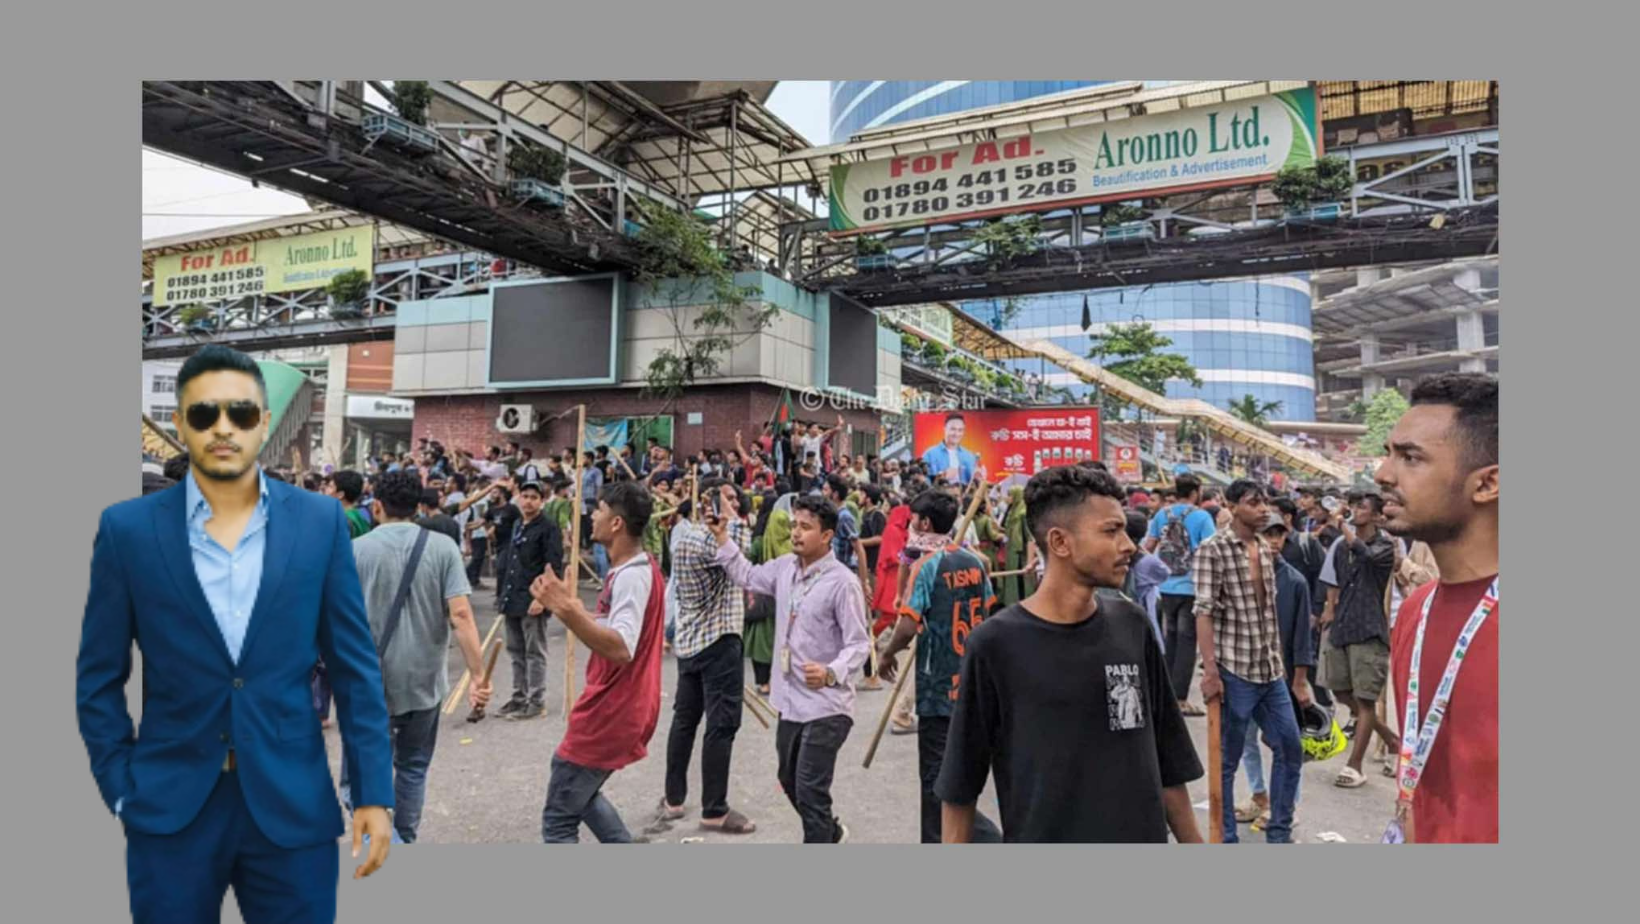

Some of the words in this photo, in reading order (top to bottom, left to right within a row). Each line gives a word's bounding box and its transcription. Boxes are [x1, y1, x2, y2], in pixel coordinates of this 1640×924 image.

[1093, 127, 1198, 170] Aronno
[1206, 105, 1270, 154] Ltd.
[890, 152, 959, 178] For
[972, 134, 1045, 165] Ad.
[1092, 168, 1168, 187] Beautification
[1170, 164, 1178, 177] &
[1181, 153, 1268, 177] Advertisement
[863, 177, 948, 203] 01894
[956, 168, 1007, 188] 441
[1014, 158, 1077, 181] 585
[863, 196, 949, 222] 01780
[956, 188, 1009, 208] 391
[1017, 178, 1077, 199] 246
[181, 253, 215, 272] For
[220, 245, 254, 266] Ad.
[284, 244, 330, 266] Aronno
[332, 235, 358, 260] Ltd.
[166, 287, 207, 301] 01780
[209, 284, 234, 297] 391
[237, 280, 264, 293] 246
[167, 274, 207, 289] 01894
[211, 271, 233, 283] 441
[236, 265, 264, 280] 585
[1105, 664, 1139, 677] PABLO
